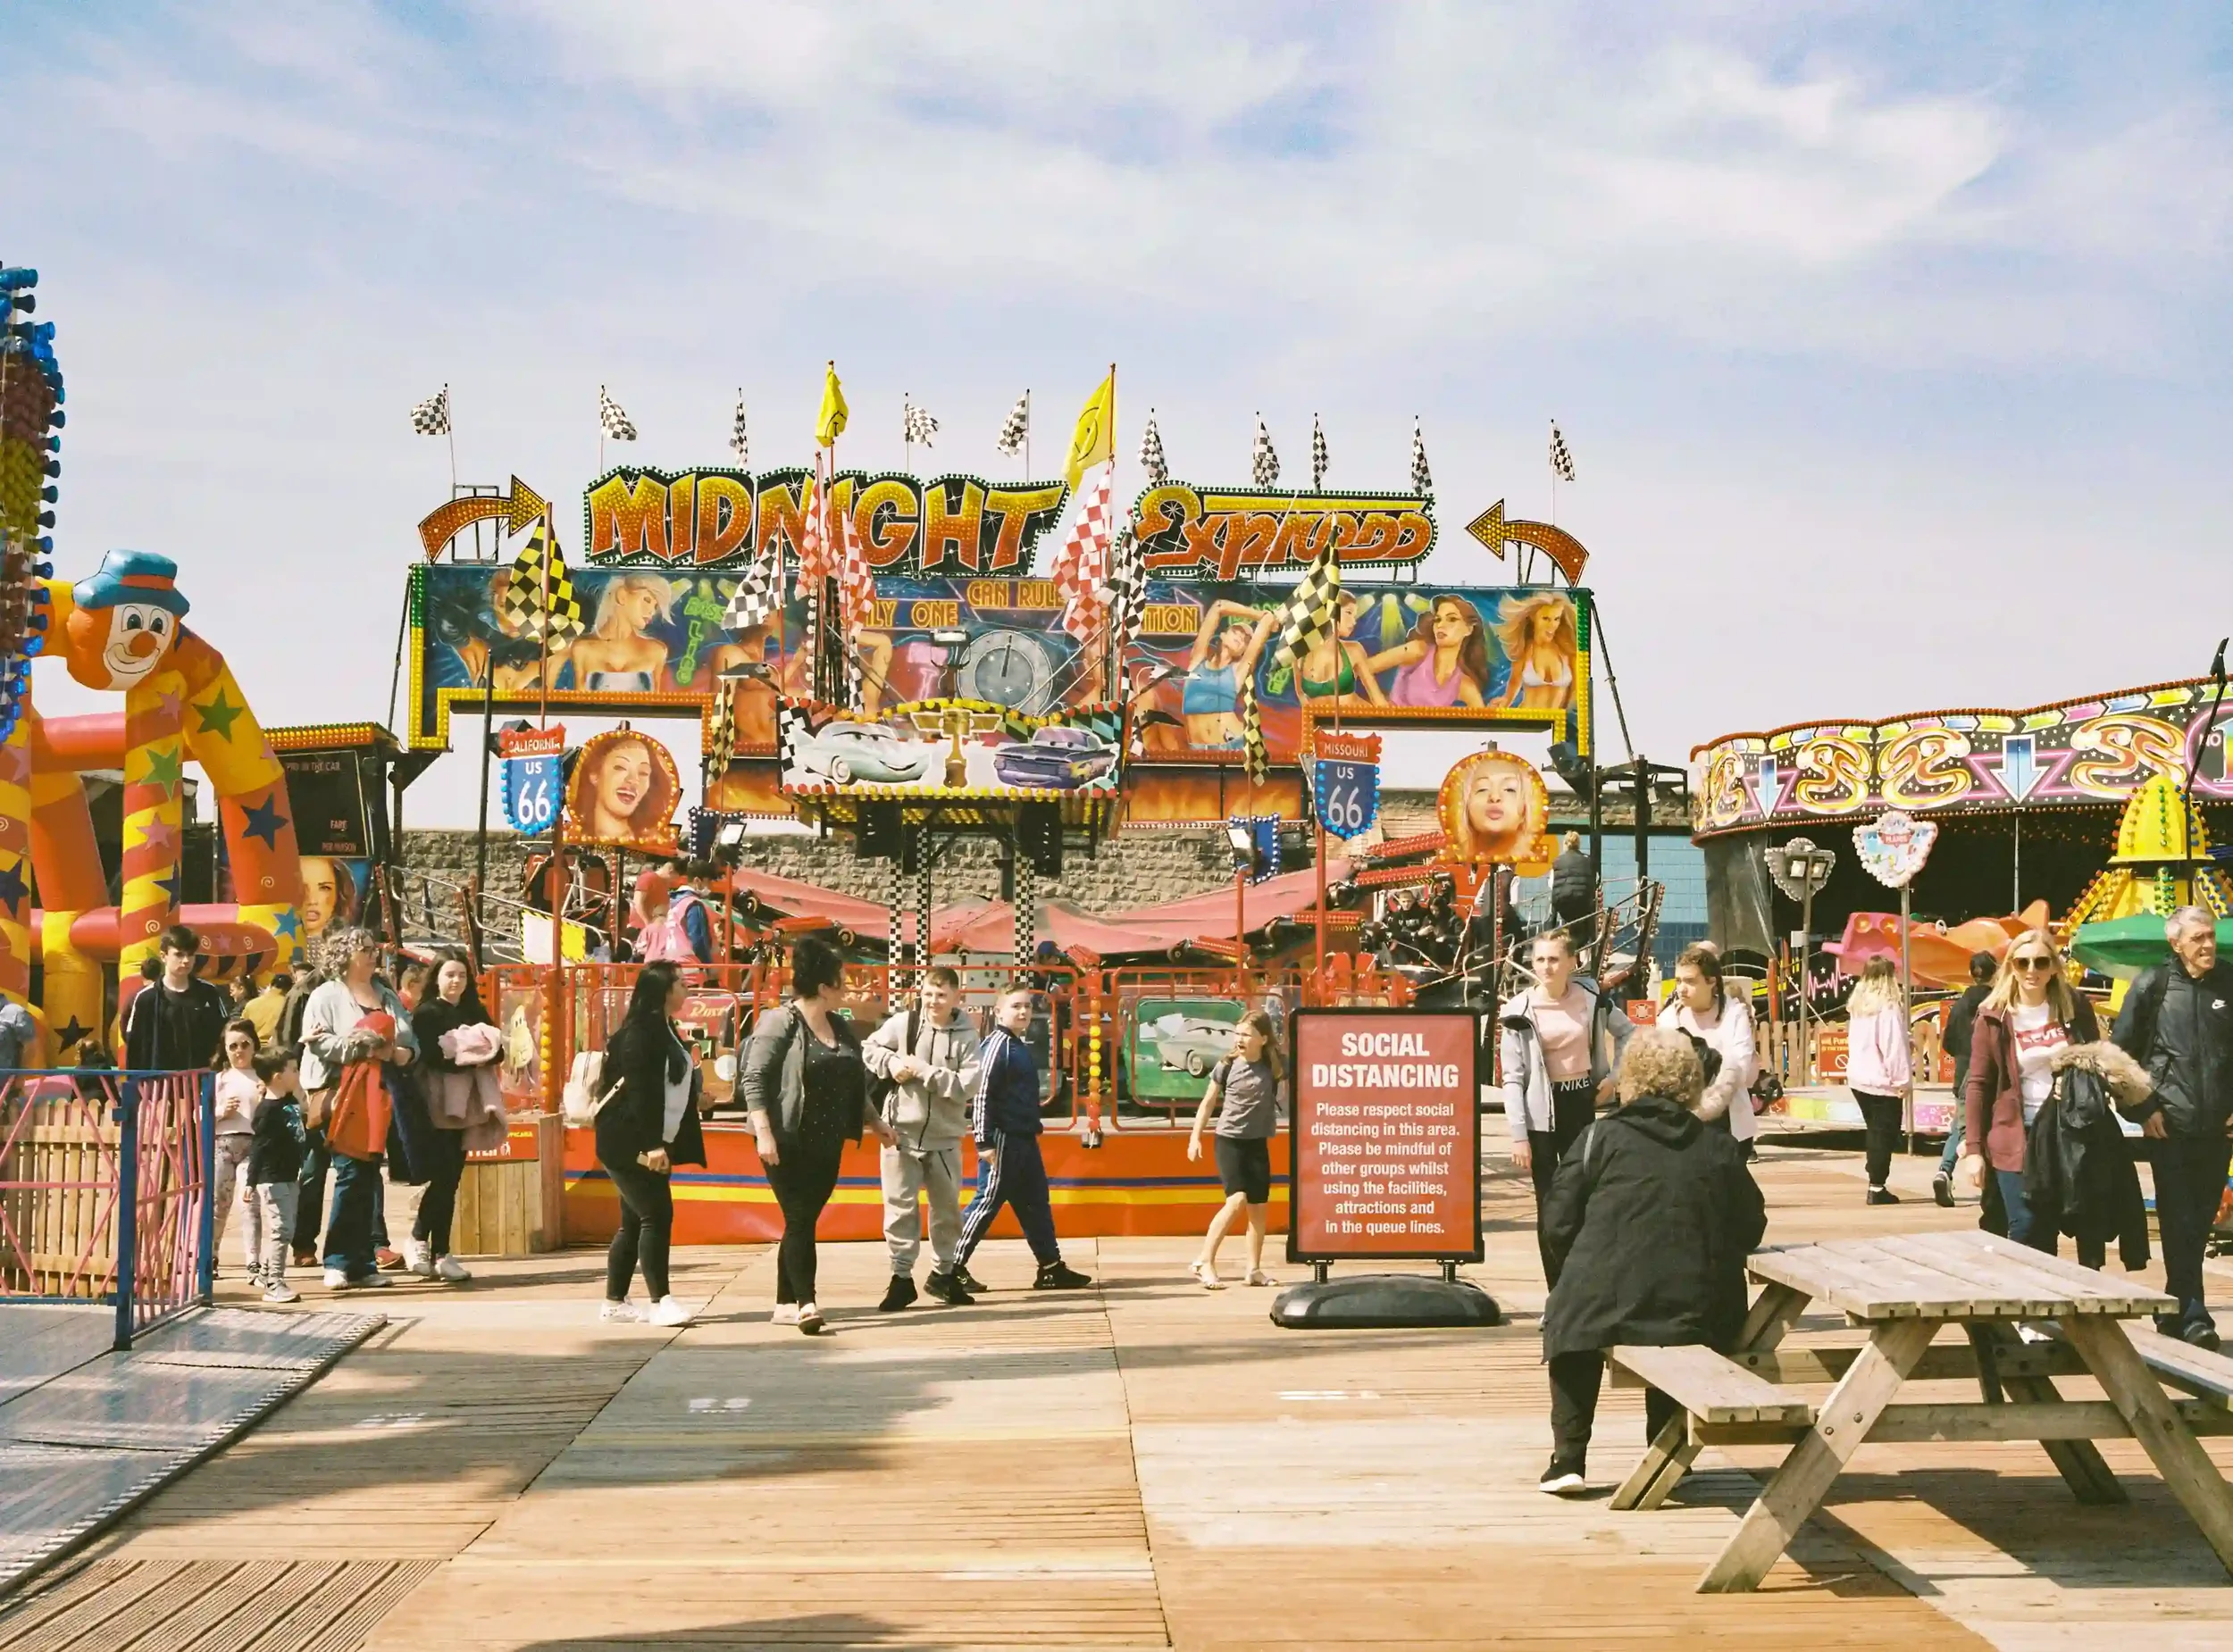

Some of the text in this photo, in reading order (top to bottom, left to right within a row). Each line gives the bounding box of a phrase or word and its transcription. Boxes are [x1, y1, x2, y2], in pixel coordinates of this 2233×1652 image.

[589, 472, 1066, 572] MIDNIGHT
[966, 580, 1068, 609] CAN RULE
[865, 600, 959, 628] LY ONE
[1143, 605, 1199, 633] TION
[508, 737, 561, 754] CALIFORNIA
[1323, 743, 1368, 758] MISSOURI
[525, 761, 543, 775] US
[1336, 765, 1354, 780] US
[518, 779, 551, 825] 66
[1327, 785, 1363, 829] 66
[1342, 1032, 1430, 1057] SOCIAL
[1311, 1064, 1459, 1089] DISTANCING
[1560, 1078, 1590, 1092] NIKE
[1316, 1103, 1454, 1120] Please respect social
[1310, 1122, 1460, 1139] distancing in this area.
[1318, 1141, 1453, 1156] Please be mindful of
[1321, 1162, 1450, 1178] other groups whilst
[1323, 1181, 1447, 1197] using the facilities,
[1335, 1200, 1435, 1214] attractions and
[1326, 1220, 1445, 1236] in the queue lines.
